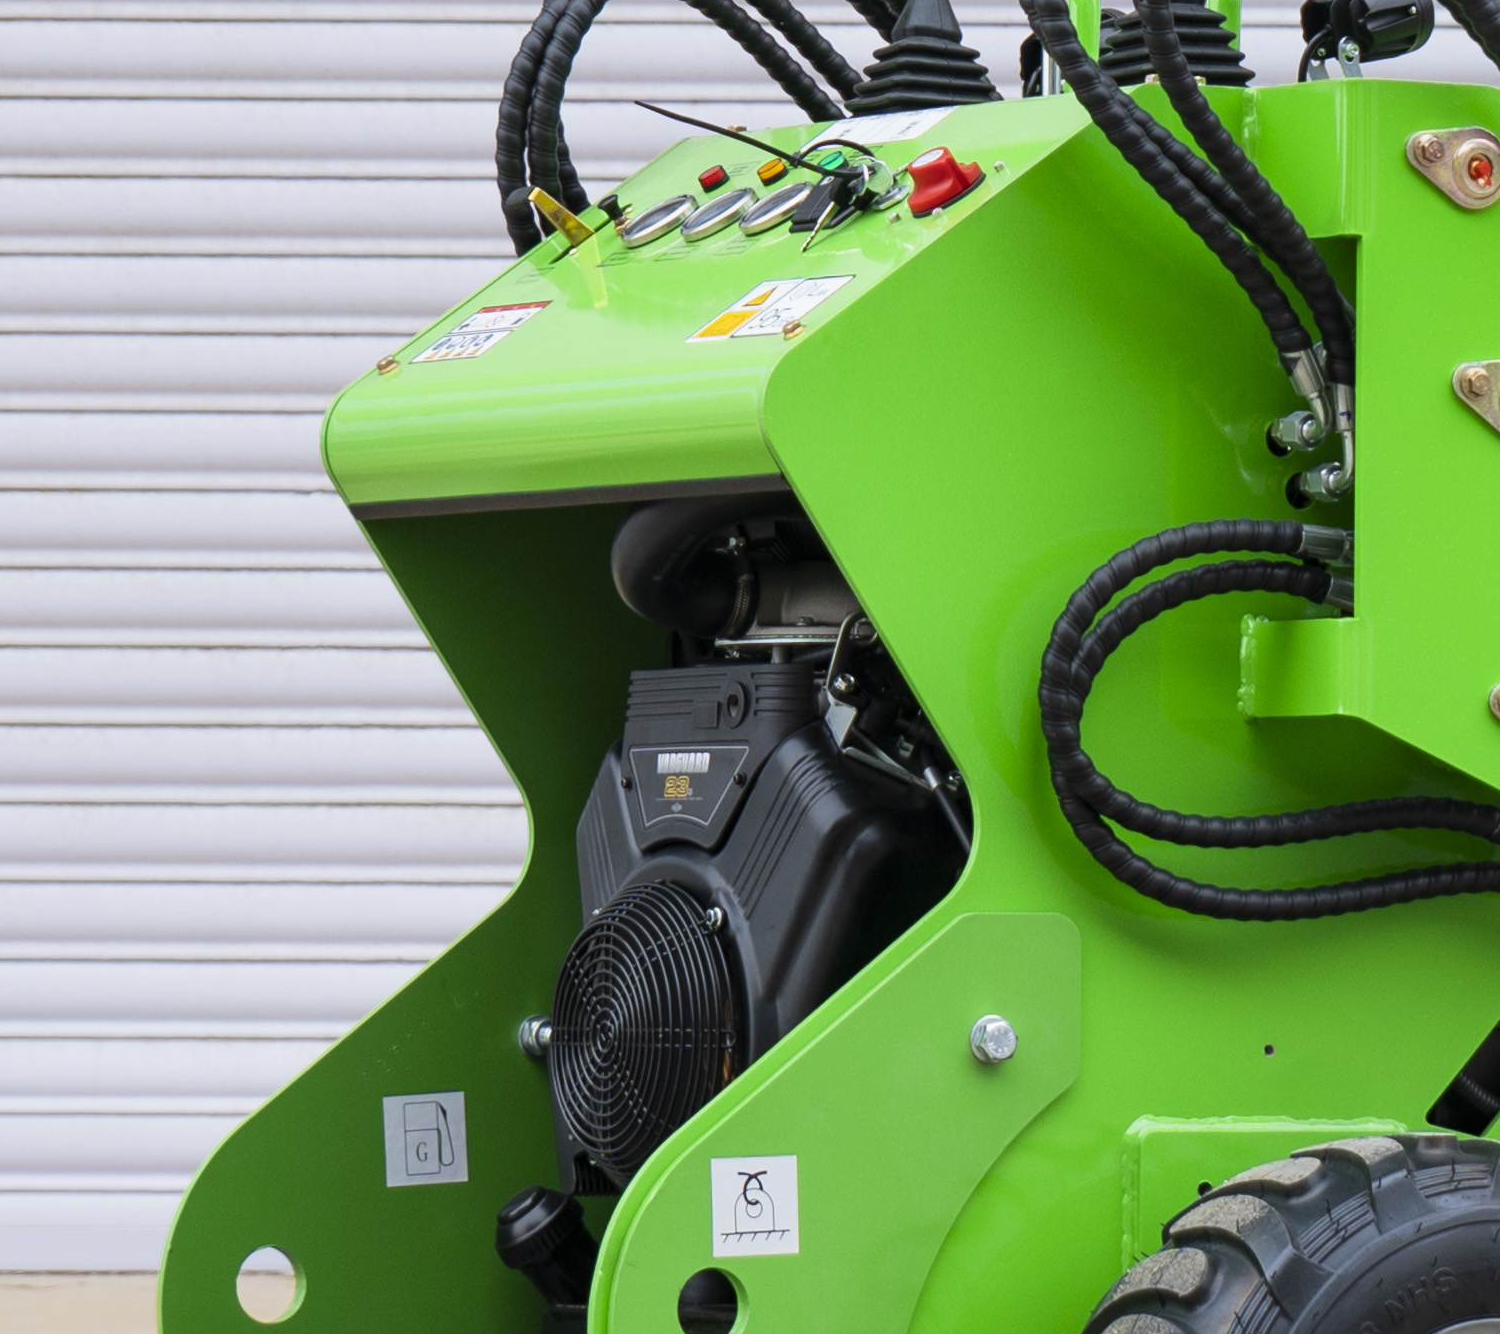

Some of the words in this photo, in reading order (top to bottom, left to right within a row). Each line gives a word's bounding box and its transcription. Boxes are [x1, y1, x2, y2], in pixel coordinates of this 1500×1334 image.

[657, 752, 710, 773] VANGUARD
[664, 775, 690, 797] 23
[416, 1141, 428, 1163] G
[1383, 1264, 1457, 1329] NHS
